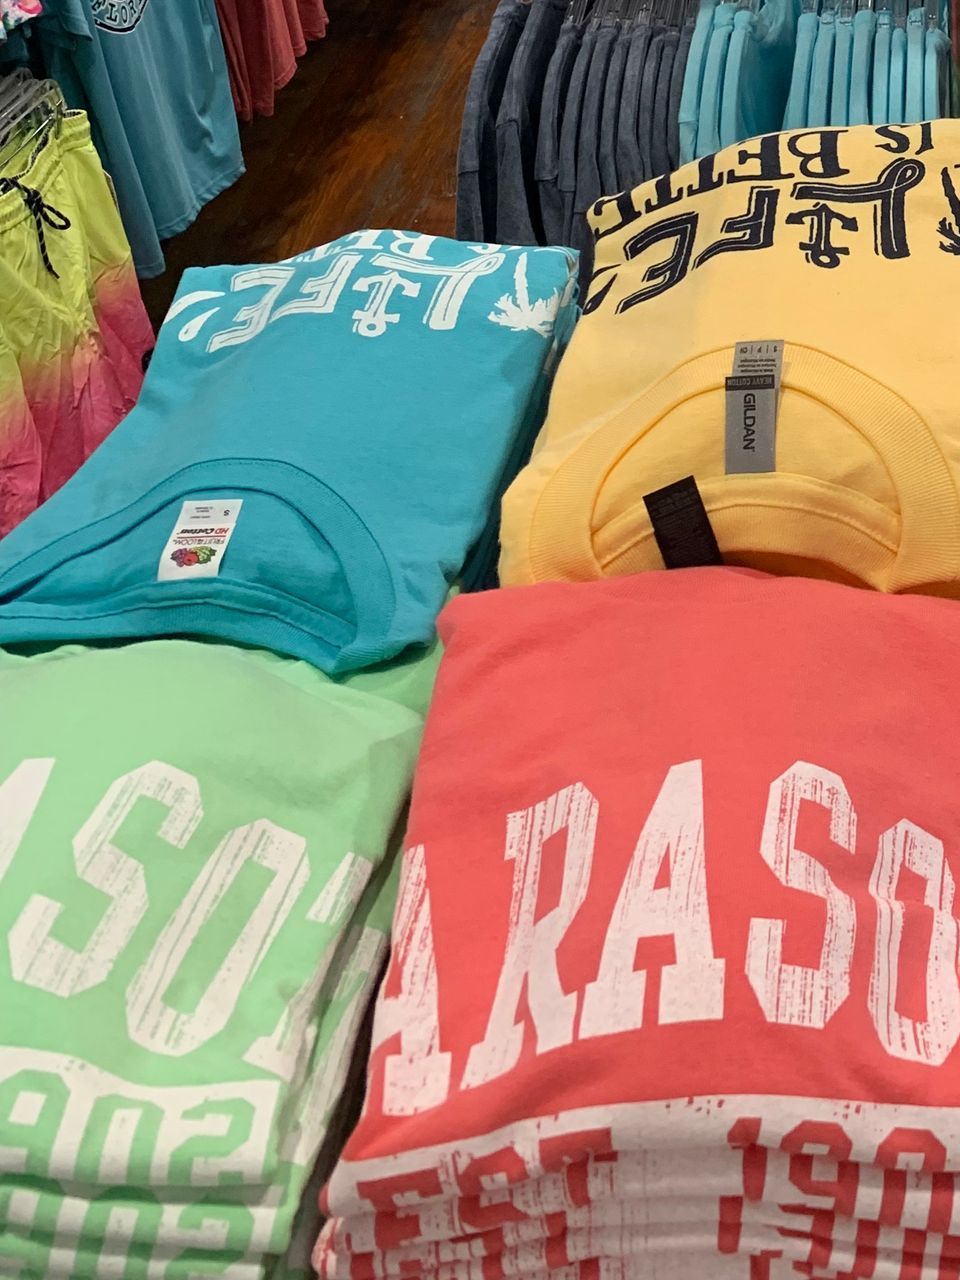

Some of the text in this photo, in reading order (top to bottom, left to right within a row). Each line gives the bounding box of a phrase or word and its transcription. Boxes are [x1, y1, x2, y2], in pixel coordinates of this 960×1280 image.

[874, 121, 934, 156] IS
[742, 392, 756, 453] GILDAN
[214, 527, 230, 535] HD
